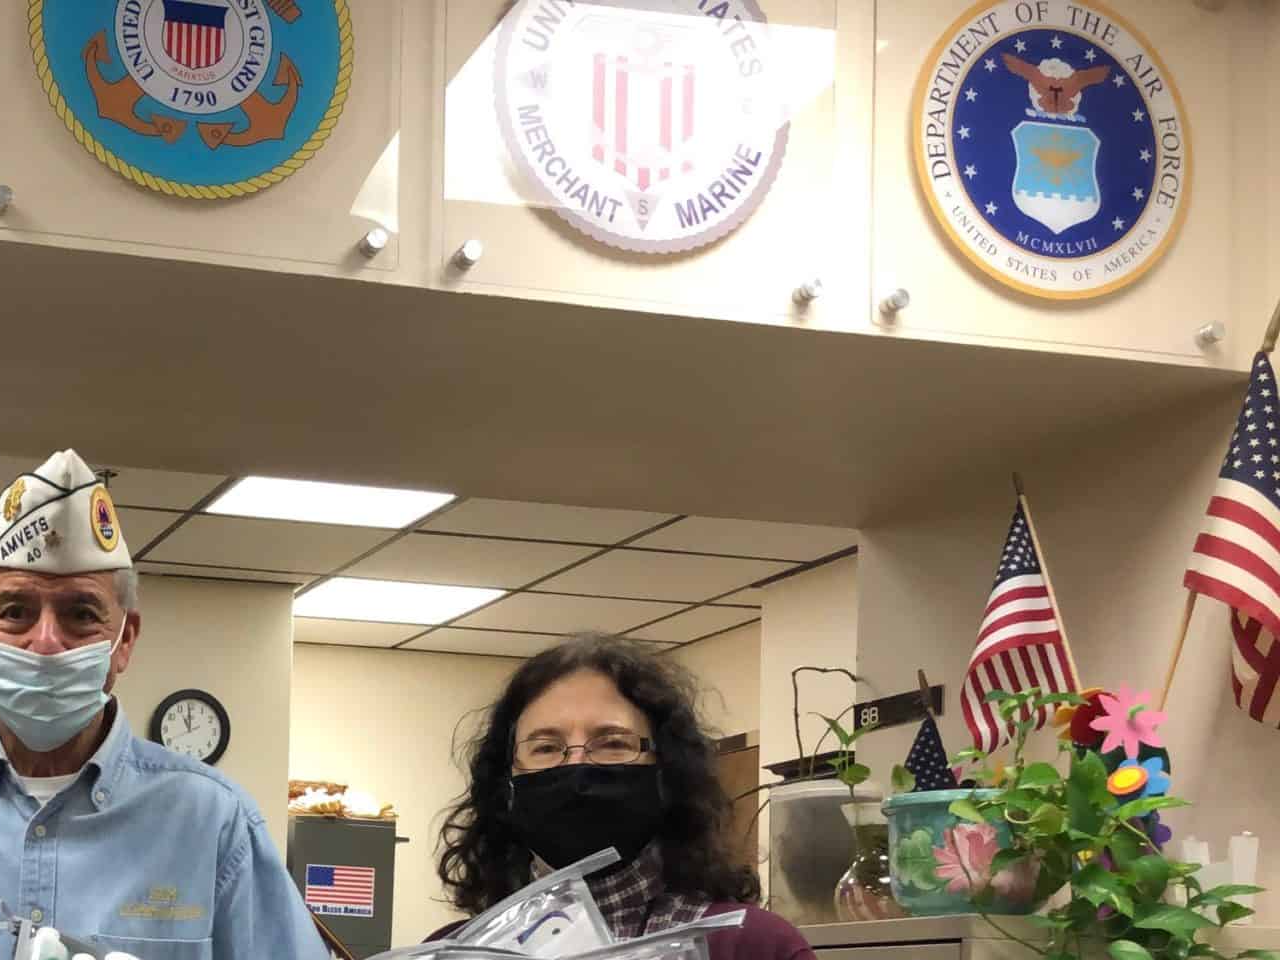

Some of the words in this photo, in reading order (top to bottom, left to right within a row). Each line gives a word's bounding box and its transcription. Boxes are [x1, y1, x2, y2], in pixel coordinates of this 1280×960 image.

[122, 0, 154, 80] UNITED
[231, 26, 266, 93] GUARD
[171, 87, 218, 107] 1790
[926, 11, 1001, 181] DEPARTMENT
[1014, 1, 1049, 25] OF
[1067, 5, 1119, 47] THE
[1126, 53, 1163, 98] AIR
[1156, 114, 1182, 210] FORCE
[517, 103, 623, 223] MERCHANT
[674, 143, 762, 229] MARINE
[951, 205, 998, 257] UNITED
[1005, 256, 1058, 282] STATES
[1072, 267, 1094, 282] OF
[1103, 228, 1158, 275] AMERICA
[1016, 231, 1098, 255] MCMXLVII
[0, 516, 50, 561] AMVETS
